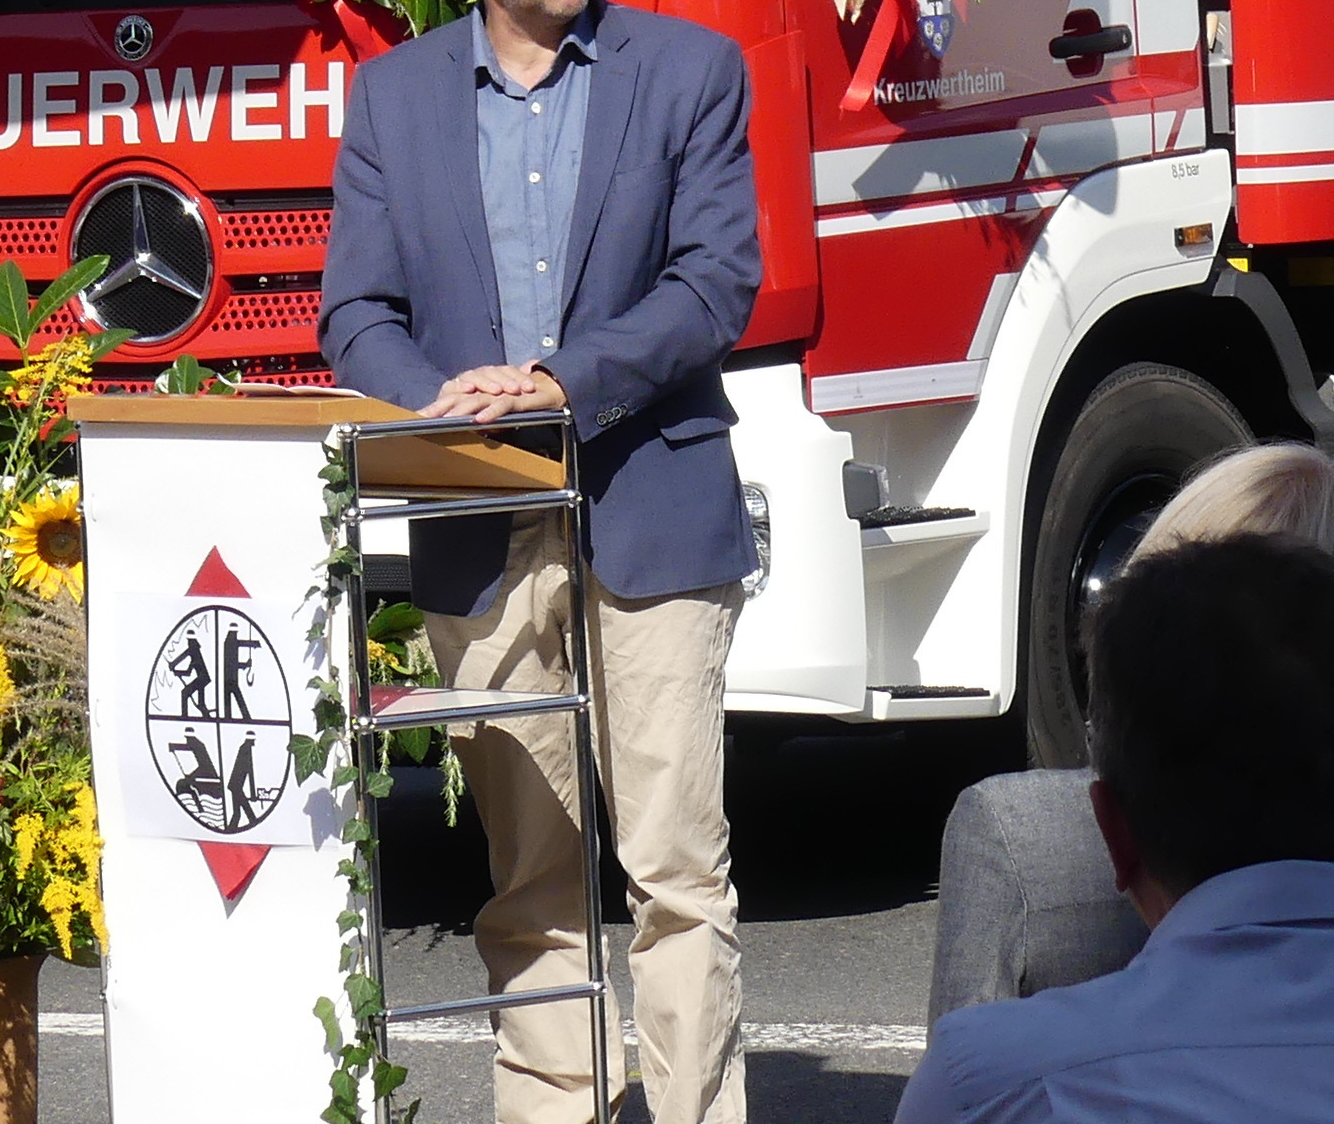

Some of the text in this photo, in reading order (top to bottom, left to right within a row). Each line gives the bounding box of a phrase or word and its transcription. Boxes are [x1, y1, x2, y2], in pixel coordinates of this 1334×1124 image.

[873, 68, 1006, 106] Kreuzwertheim
[1171, 162, 1200, 179] 8,5 bar
